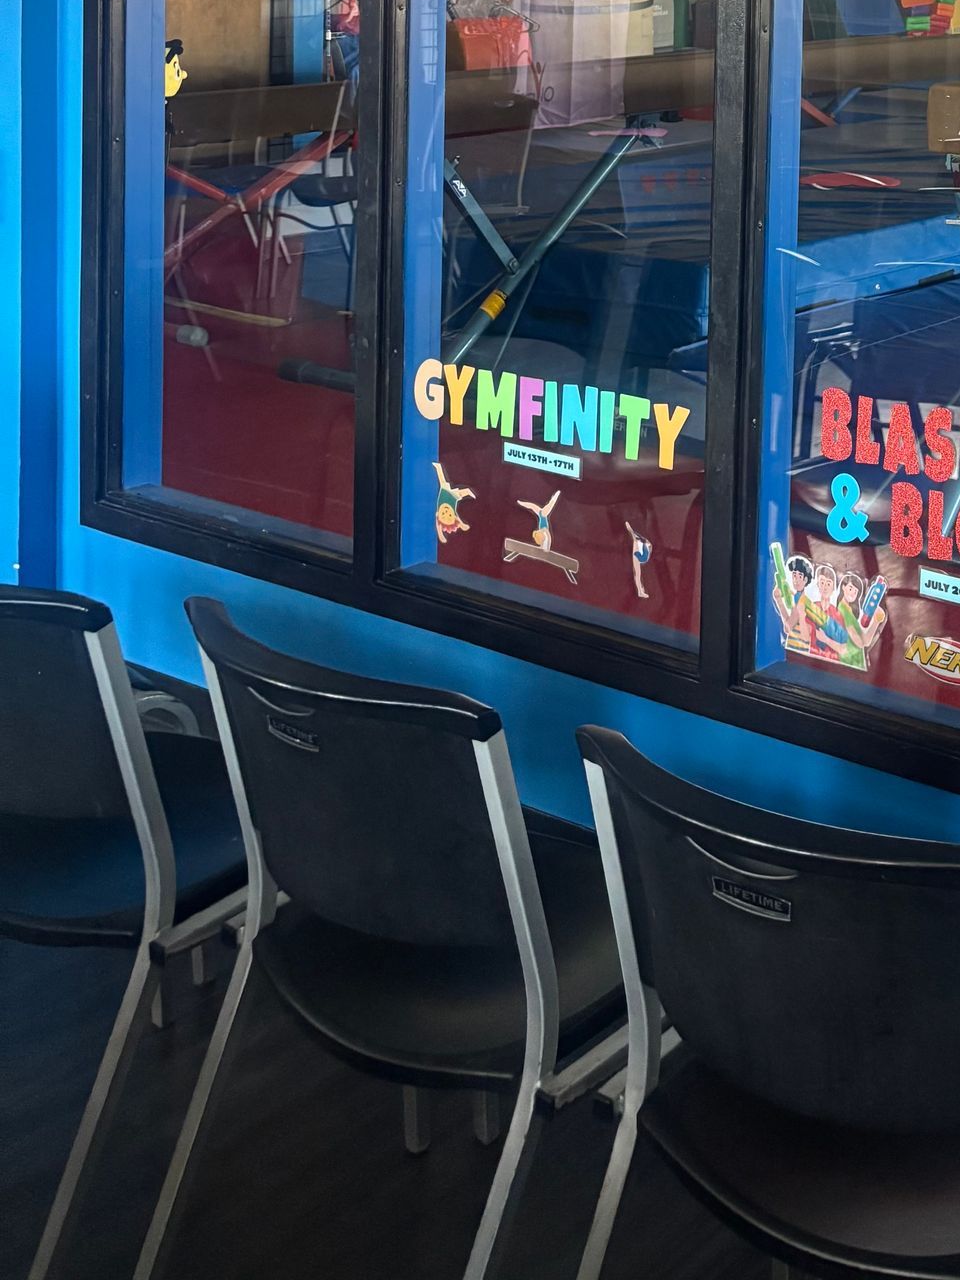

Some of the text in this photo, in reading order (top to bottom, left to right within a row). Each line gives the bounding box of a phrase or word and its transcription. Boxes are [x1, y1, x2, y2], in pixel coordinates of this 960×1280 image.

[414, 358, 690, 470] GYMFINITY
[507, 448, 527, 460] JULY
[527, 452, 548, 466] 13TH
[553, 459, 574, 471] 17TH
[826, 472, 870, 544] &
[924, 579, 950, 594] JULY
[721, 882, 784, 911] LIFETIME
